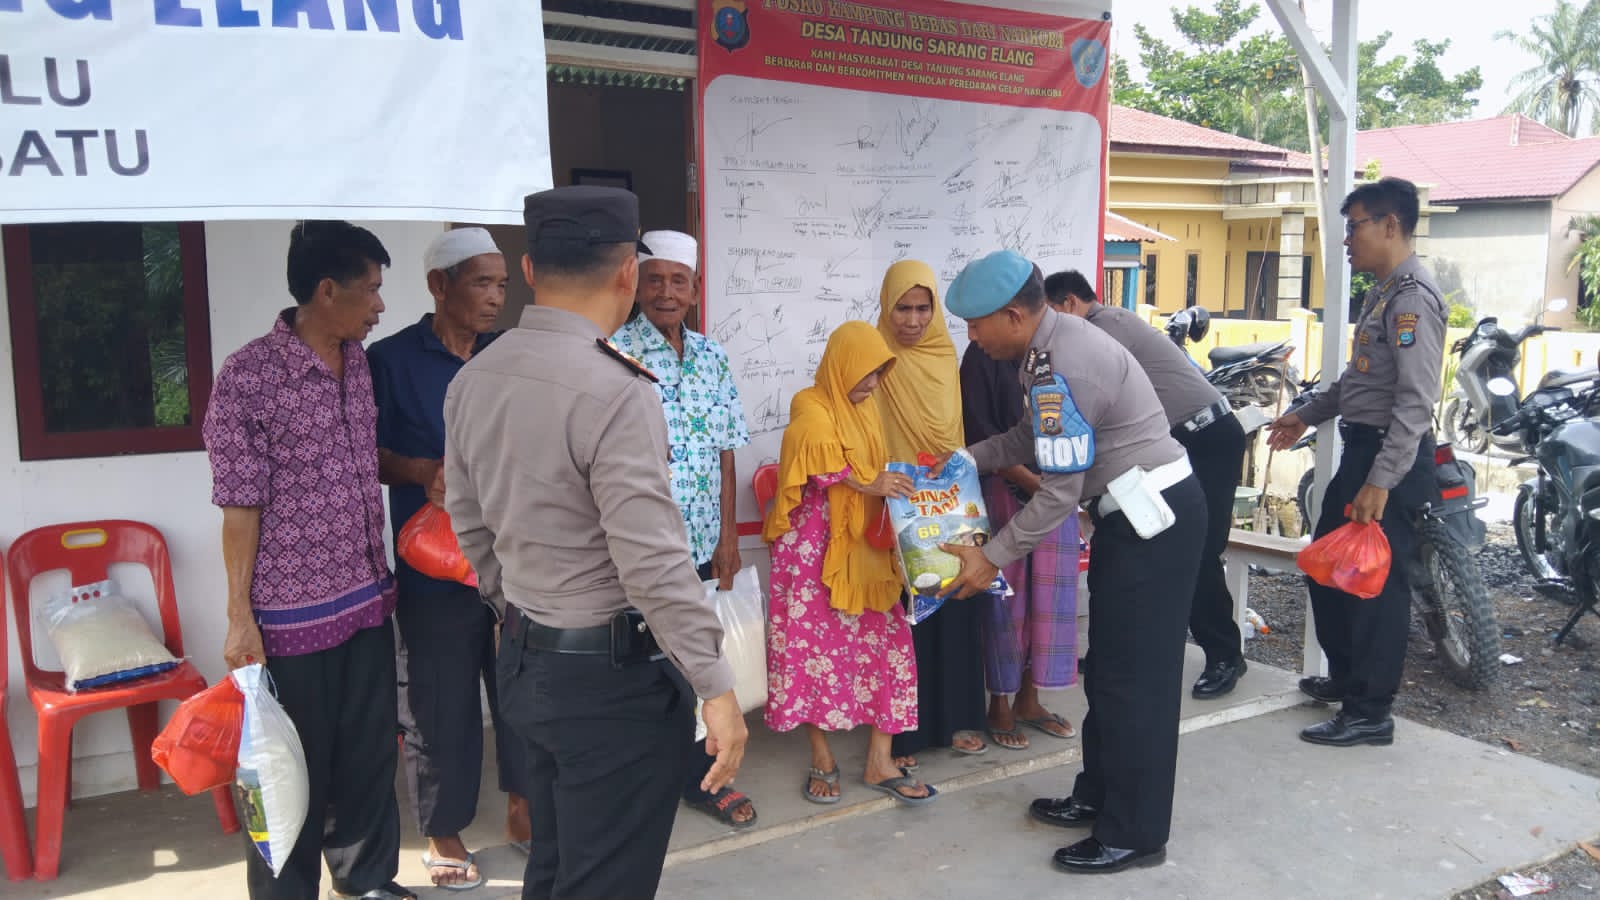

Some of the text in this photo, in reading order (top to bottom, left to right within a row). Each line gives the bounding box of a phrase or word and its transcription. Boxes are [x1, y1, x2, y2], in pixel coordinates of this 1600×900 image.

[827, 0, 905, 27] KAMPUNG
[909, 14, 957, 34] BEBAS
[960, 22, 997, 40] DARI
[801, 21, 1034, 66] DESA TANJUNG SARANG ELANG
[764, 55, 813, 71] BERIKRAR
[815, 62, 835, 73] DAN
[838, 65, 904, 81] BERKOMITMEN
[906, 73, 946, 86] MENOLAK
[949, 77, 996, 93] PEREDARAN
[998, 84, 1022, 95] GELAP
[810, 49, 1025, 83] KAMI MASYARAKAT DESA TANJUNG SARANG ELANG
[0, 129, 150, 177] ATU
[908, 482, 960, 505] SINAR
[916, 495, 960, 518] TANI
[917, 522, 941, 540] 66
